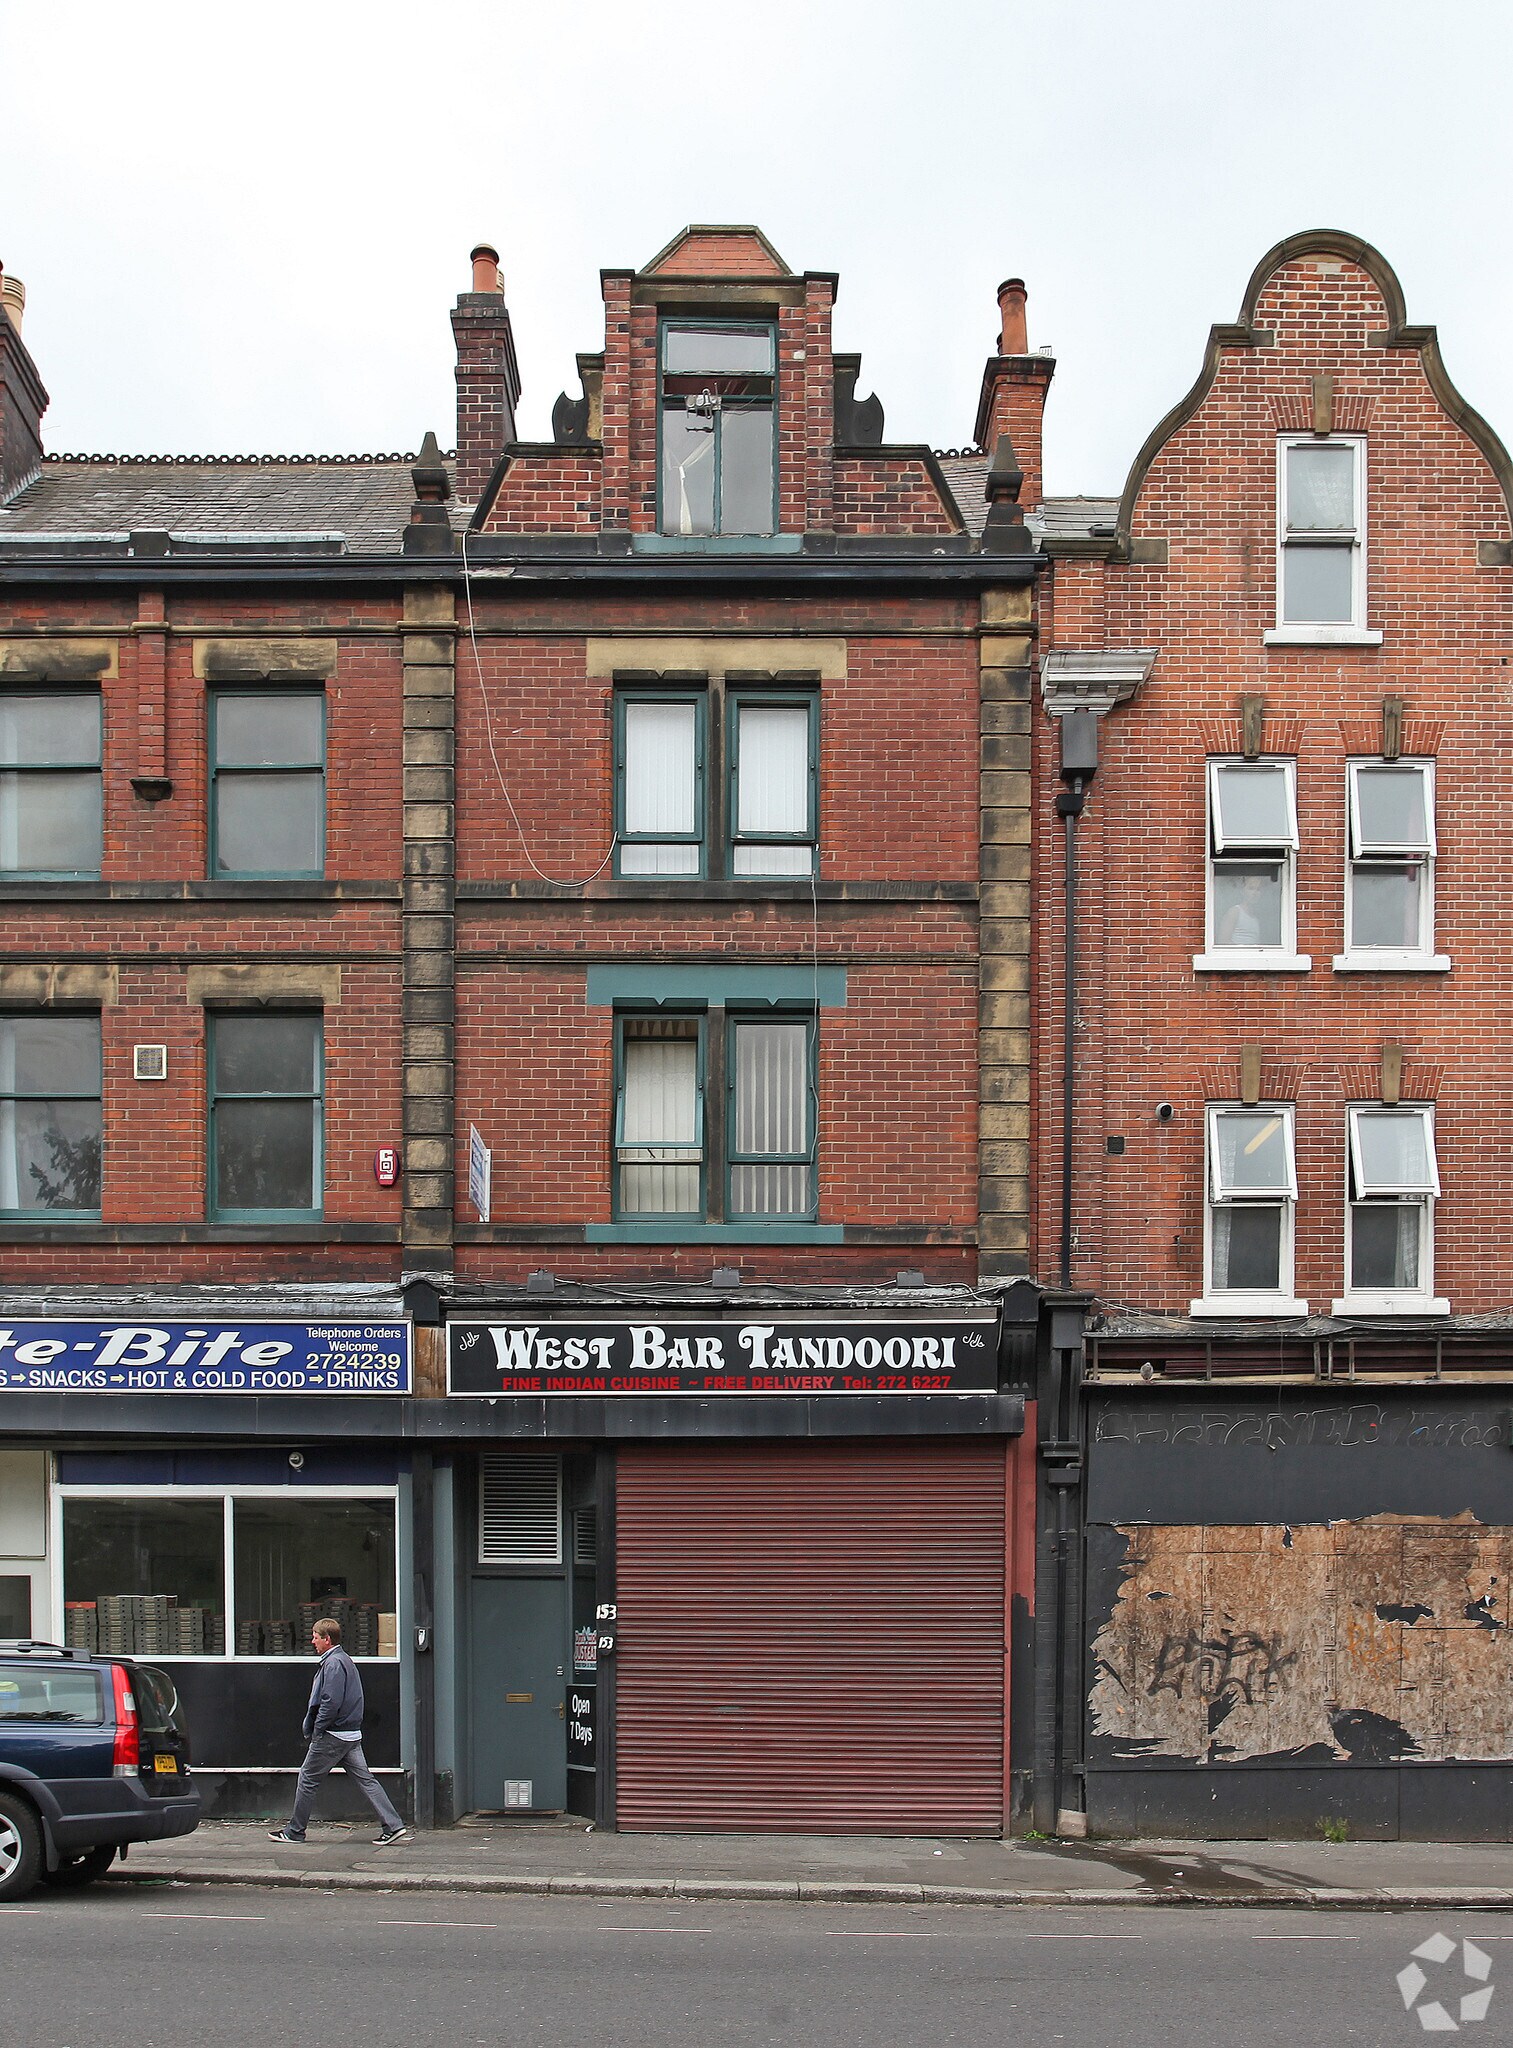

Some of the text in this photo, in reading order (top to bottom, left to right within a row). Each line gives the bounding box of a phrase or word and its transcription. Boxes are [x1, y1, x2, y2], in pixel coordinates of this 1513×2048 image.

[306, 1327, 401, 1340] Telephone Orders
[329, 1341, 378, 1352] Welcome
[488, 1325, 956, 1370] WEST BAR TANDOORI
[306, 1353, 401, 1370] 2724239
[29, 1370, 107, 1387] SNACKS
[128, 1371, 169, 1387] HOT
[173, 1371, 188, 1387] &
[192, 1371, 245, 1388] COLD
[251, 1371, 306, 1388] FOOD
[327, 1371, 398, 1388] DRINKS
[502, 1377, 541, 1390] FINE
[546, 1377, 606, 1390] INDIAN
[610, 1376, 681, 1390] CUISINE
[703, 1376, 747, 1389] FREE
[751, 1375, 835, 1389] DELIVERY
[842, 1375, 873, 1389] Tel:
[876, 1375, 907, 1389] 272
[911, 1375, 952, 1389] 6227
[596, 1604, 617, 1620] 153
[598, 1636, 614, 1649] 153
[571, 1694, 591, 1718] Open
[569, 1721, 593, 1746] 7 Days
